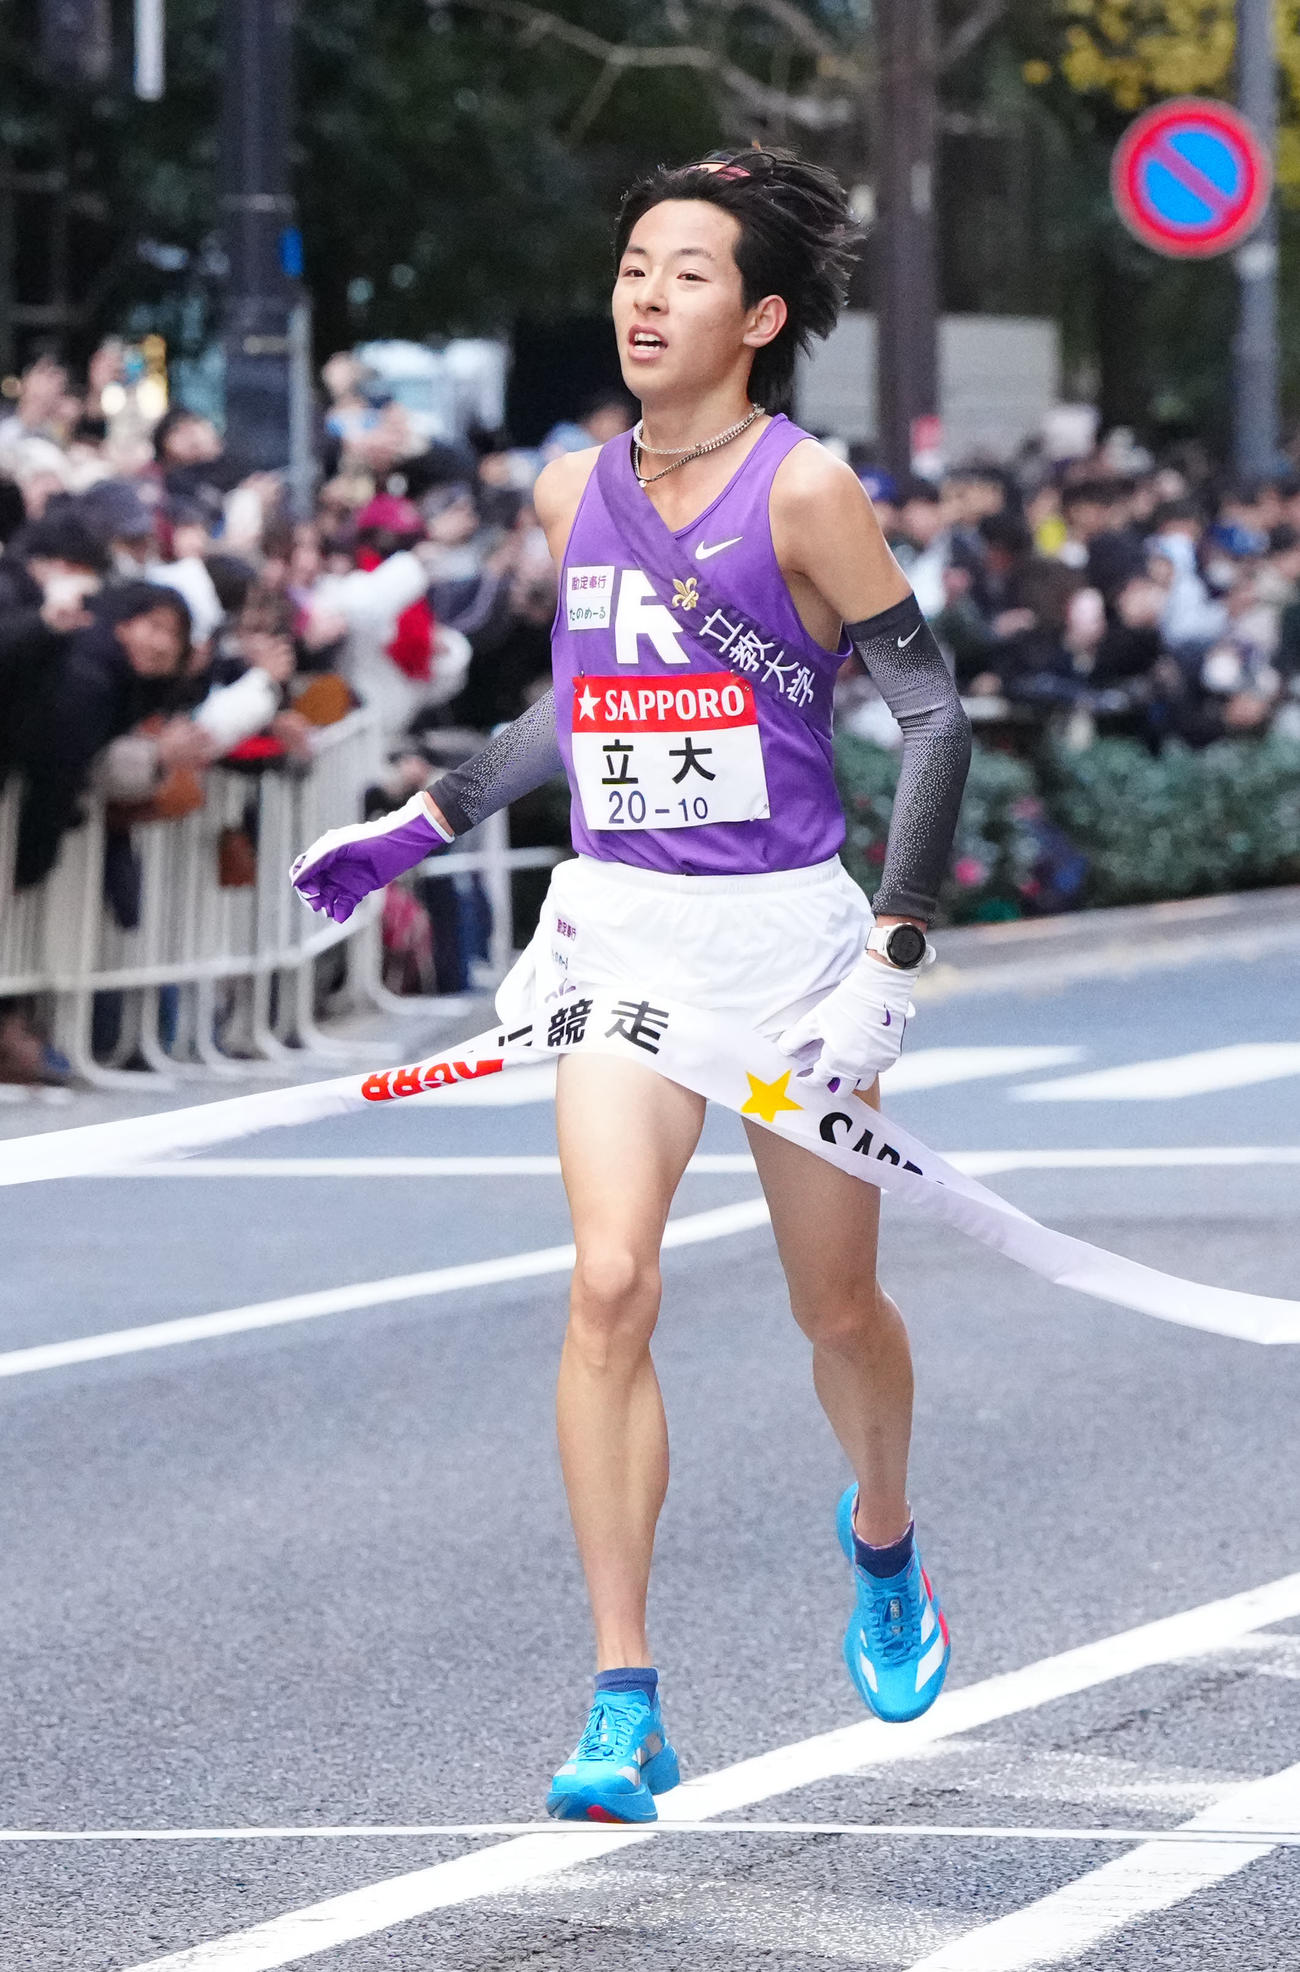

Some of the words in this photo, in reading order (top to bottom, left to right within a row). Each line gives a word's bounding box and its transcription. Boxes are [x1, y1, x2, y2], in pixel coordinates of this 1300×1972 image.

[699, 608, 815, 708] 立教大学
[604, 685, 745, 722] SAPPORO
